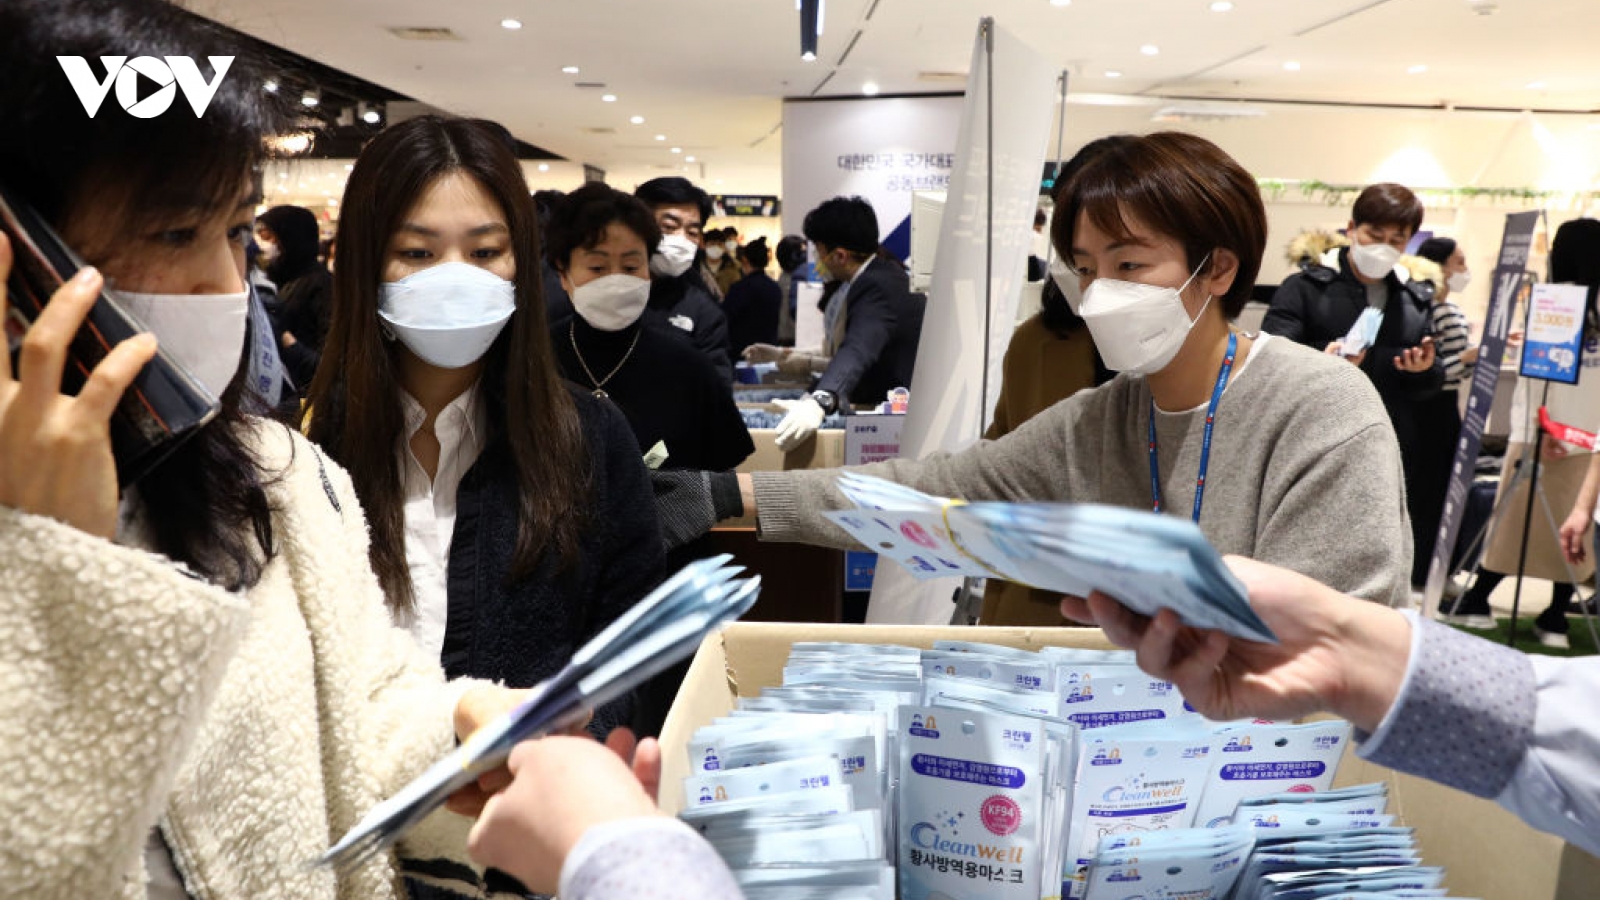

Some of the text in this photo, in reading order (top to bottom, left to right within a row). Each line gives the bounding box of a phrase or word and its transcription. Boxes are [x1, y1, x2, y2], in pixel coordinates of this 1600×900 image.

[837, 153, 894, 170] 대한민국
[1003, 729, 1032, 743] 크린웰
[799, 775, 830, 789] 크린웰
[1102, 785, 1184, 802] CleanWell
[988, 805, 1015, 818] KF94
[910, 822, 1024, 864] CleanWell
[910, 849, 1024, 884] 황사방역용마스크
